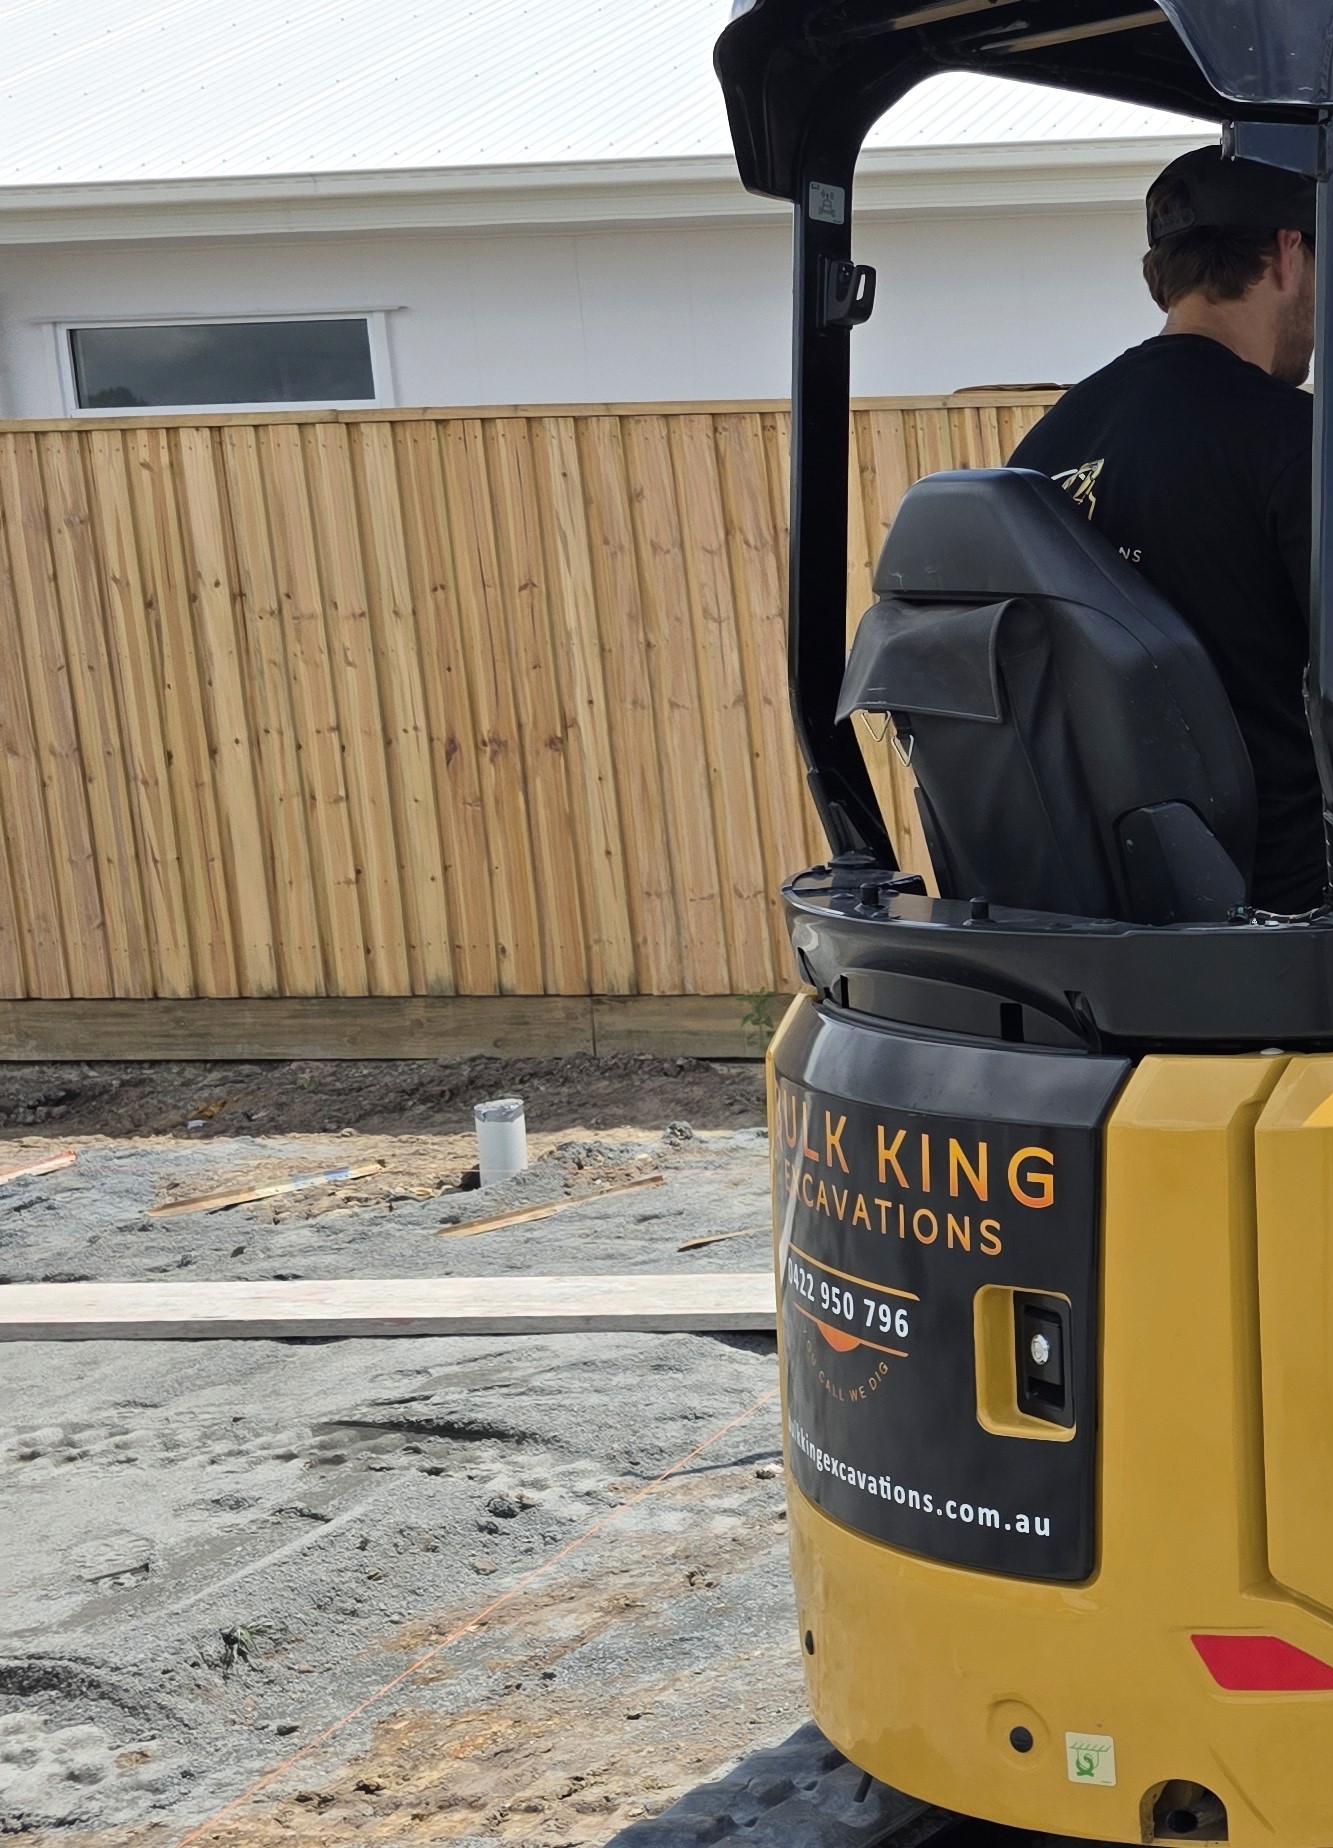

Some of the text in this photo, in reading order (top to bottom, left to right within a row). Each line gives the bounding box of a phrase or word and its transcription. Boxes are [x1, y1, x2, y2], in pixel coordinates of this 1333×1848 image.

[776, 1088, 1054, 1209] ULK KING
[784, 1158, 1002, 1256] EXCAVATIONS
[787, 1257, 909, 1338] 0422 950 796
[818, 1370, 845, 1401] CALL
[850, 1385, 867, 1403] WE
[868, 1361, 889, 1391] DIG
